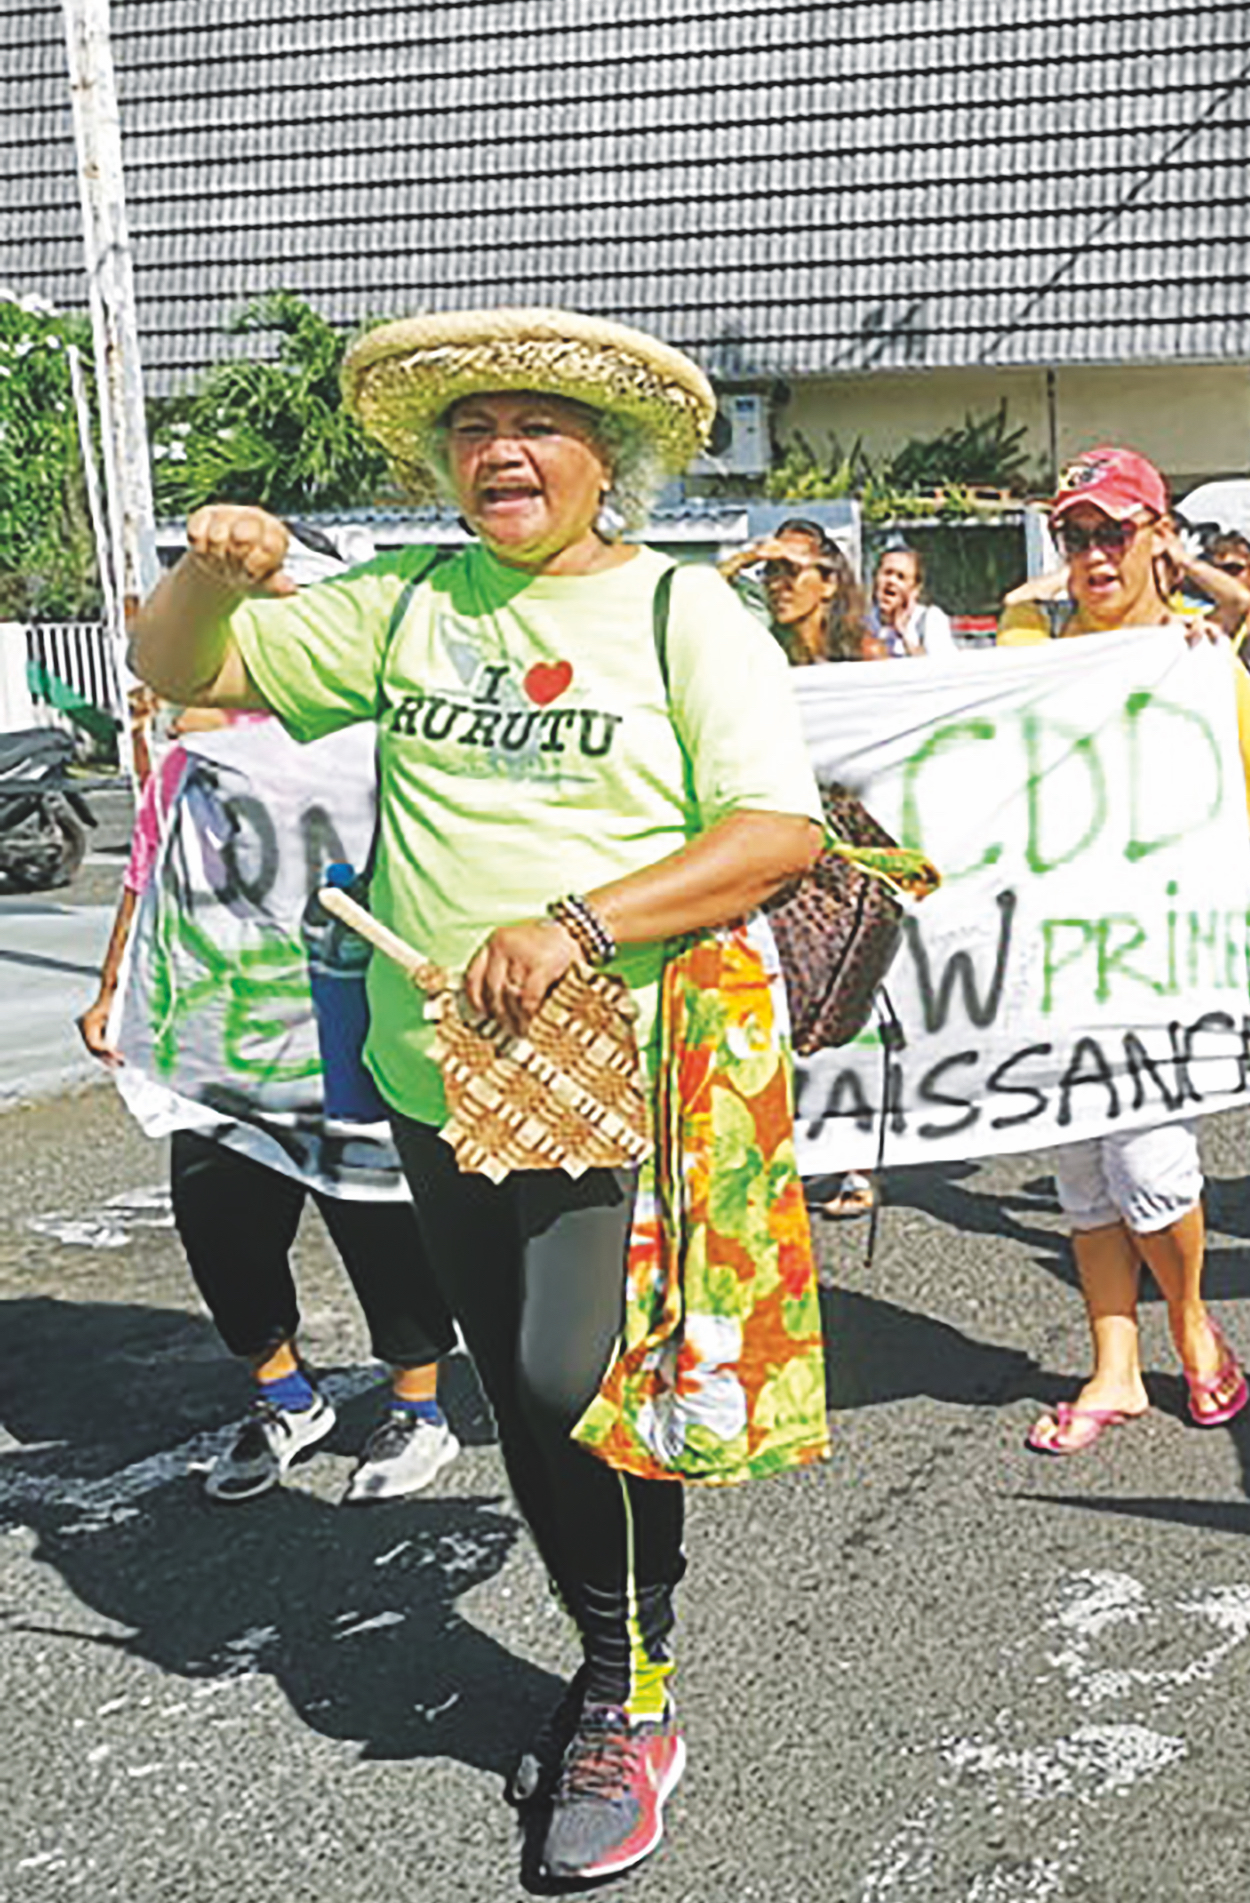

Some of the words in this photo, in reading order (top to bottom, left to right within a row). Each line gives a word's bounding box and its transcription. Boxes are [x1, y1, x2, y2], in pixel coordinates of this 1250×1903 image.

[473, 665, 511, 705] I
[391, 697, 623, 758] RURUTU
[900, 691, 1225, 885] CDD
